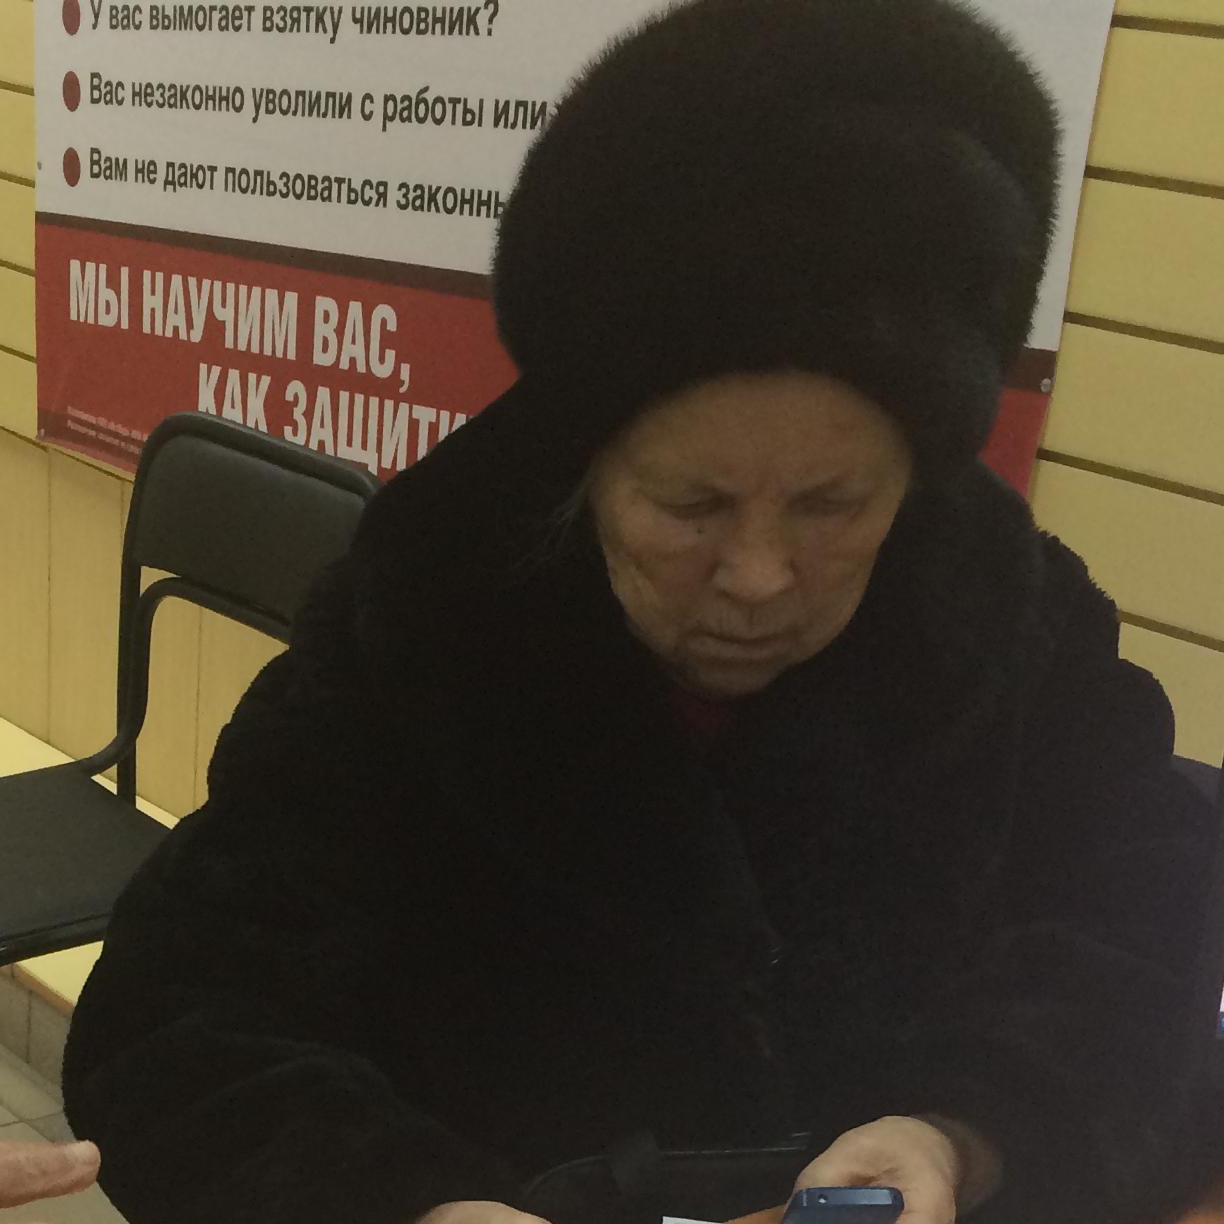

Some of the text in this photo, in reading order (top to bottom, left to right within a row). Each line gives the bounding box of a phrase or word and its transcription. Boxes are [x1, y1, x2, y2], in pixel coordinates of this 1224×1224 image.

[90, 0, 499, 44] У вас вымогает взятку чиновник?
[90, 72, 548, 132] Вас незаконно уволили с работы или
[89, 147, 128, 182] Вам
[134, 158, 158, 185] не
[163, 161, 218, 193] дают
[224, 166, 389, 208] пользоваться
[69, 259, 411, 393] МЫ НАУЧИМ ВАС,
[198, 363, 272, 433] КАК
